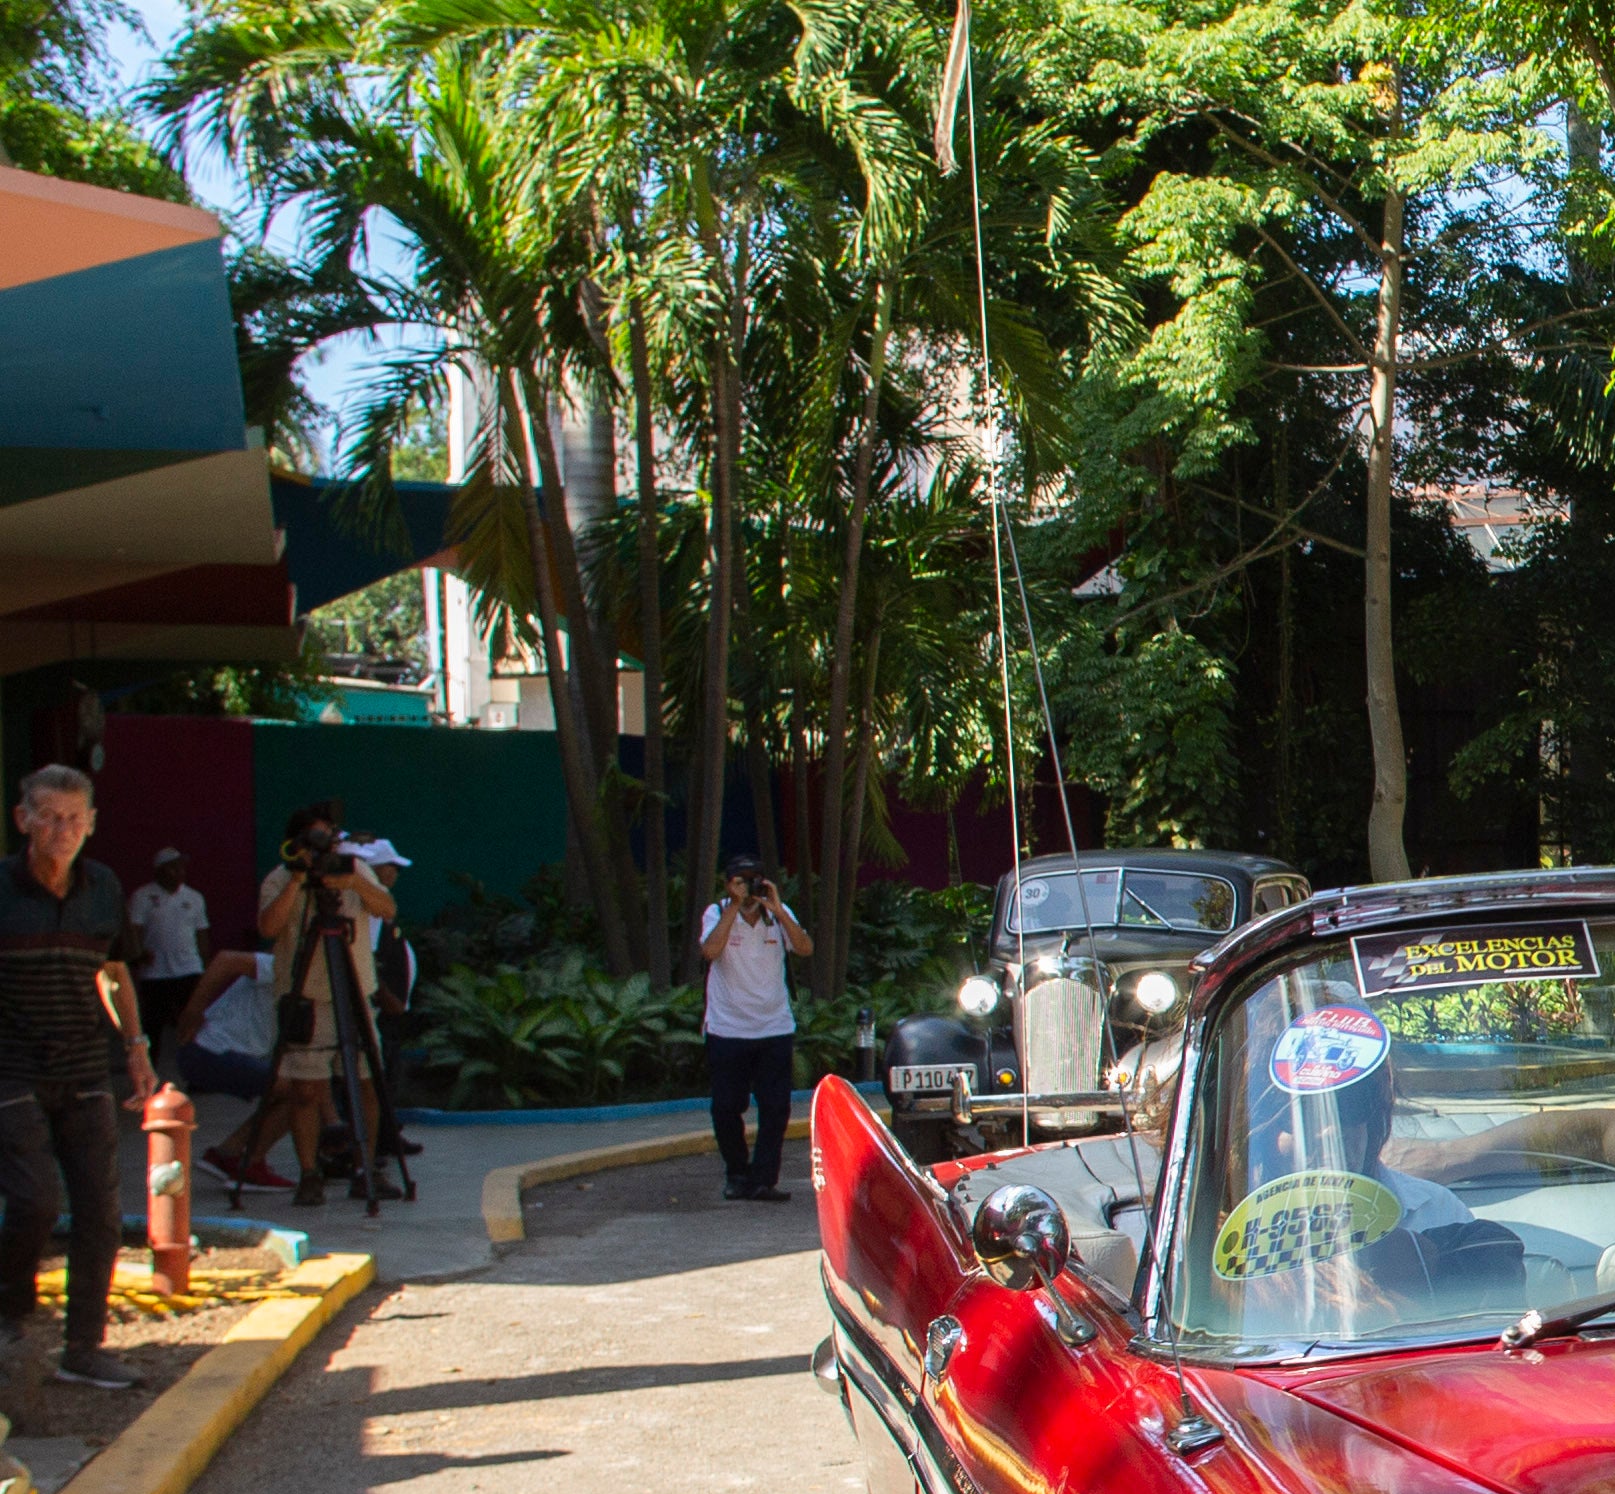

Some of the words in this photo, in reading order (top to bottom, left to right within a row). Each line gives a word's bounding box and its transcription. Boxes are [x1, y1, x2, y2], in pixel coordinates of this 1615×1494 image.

[1025, 888, 1040, 899] 30
[1405, 935, 1575, 960] EXCELENCIAS
[1409, 961, 1453, 977] DEL
[1454, 949, 1581, 973] MOTOR
[1256, 1178, 1300, 1205] AGENCIA
[1303, 1176, 1318, 1187] DE
